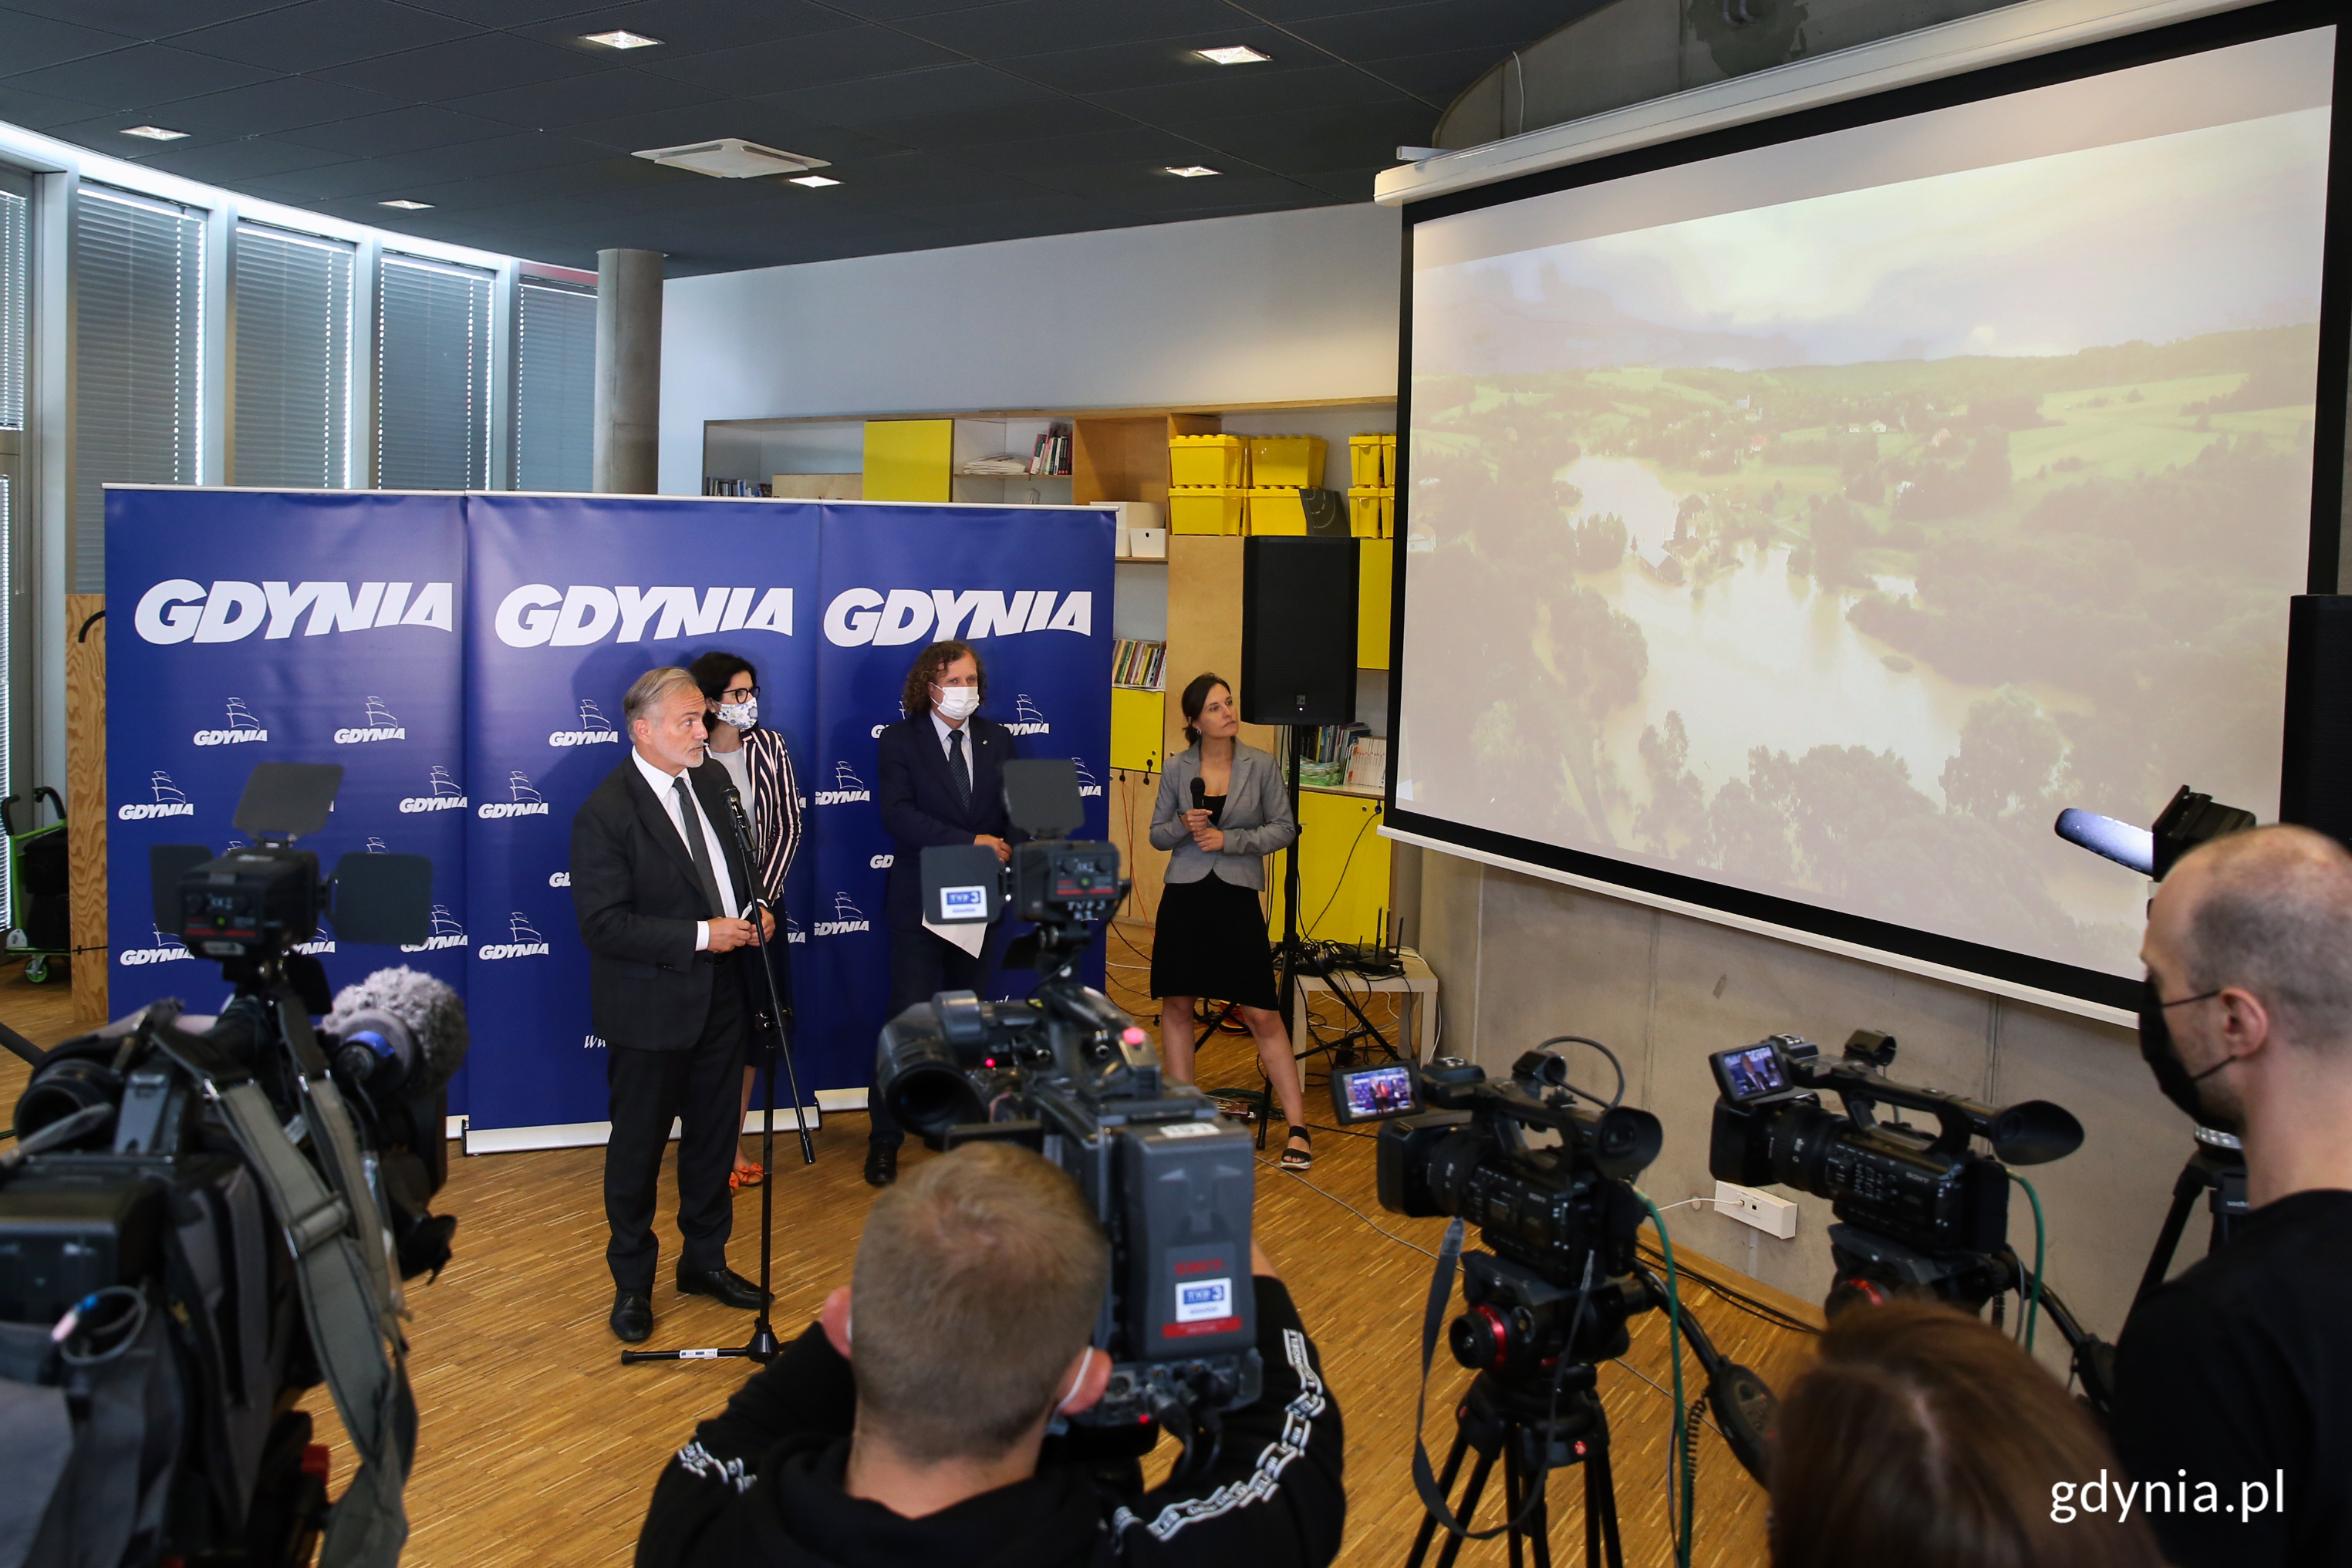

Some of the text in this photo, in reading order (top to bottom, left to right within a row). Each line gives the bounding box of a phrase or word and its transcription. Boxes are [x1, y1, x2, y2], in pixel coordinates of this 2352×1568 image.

[135, 579, 453, 645] GDYNIA
[494, 584, 794, 648] GDYNIA
[824, 588, 1092, 647] GDYNIA
[193, 729, 268, 746] GDYNIA
[334, 727, 406, 744] GDYNIA
[548, 731, 618, 747] GDYNIA
[118, 803, 194, 821] GDYNIA
[399, 797, 467, 814] GDYNIA
[477, 802, 548, 819] GDYNIA
[120, 947, 195, 966] GDYNIA
[478, 942, 549, 960] GDYNIA
